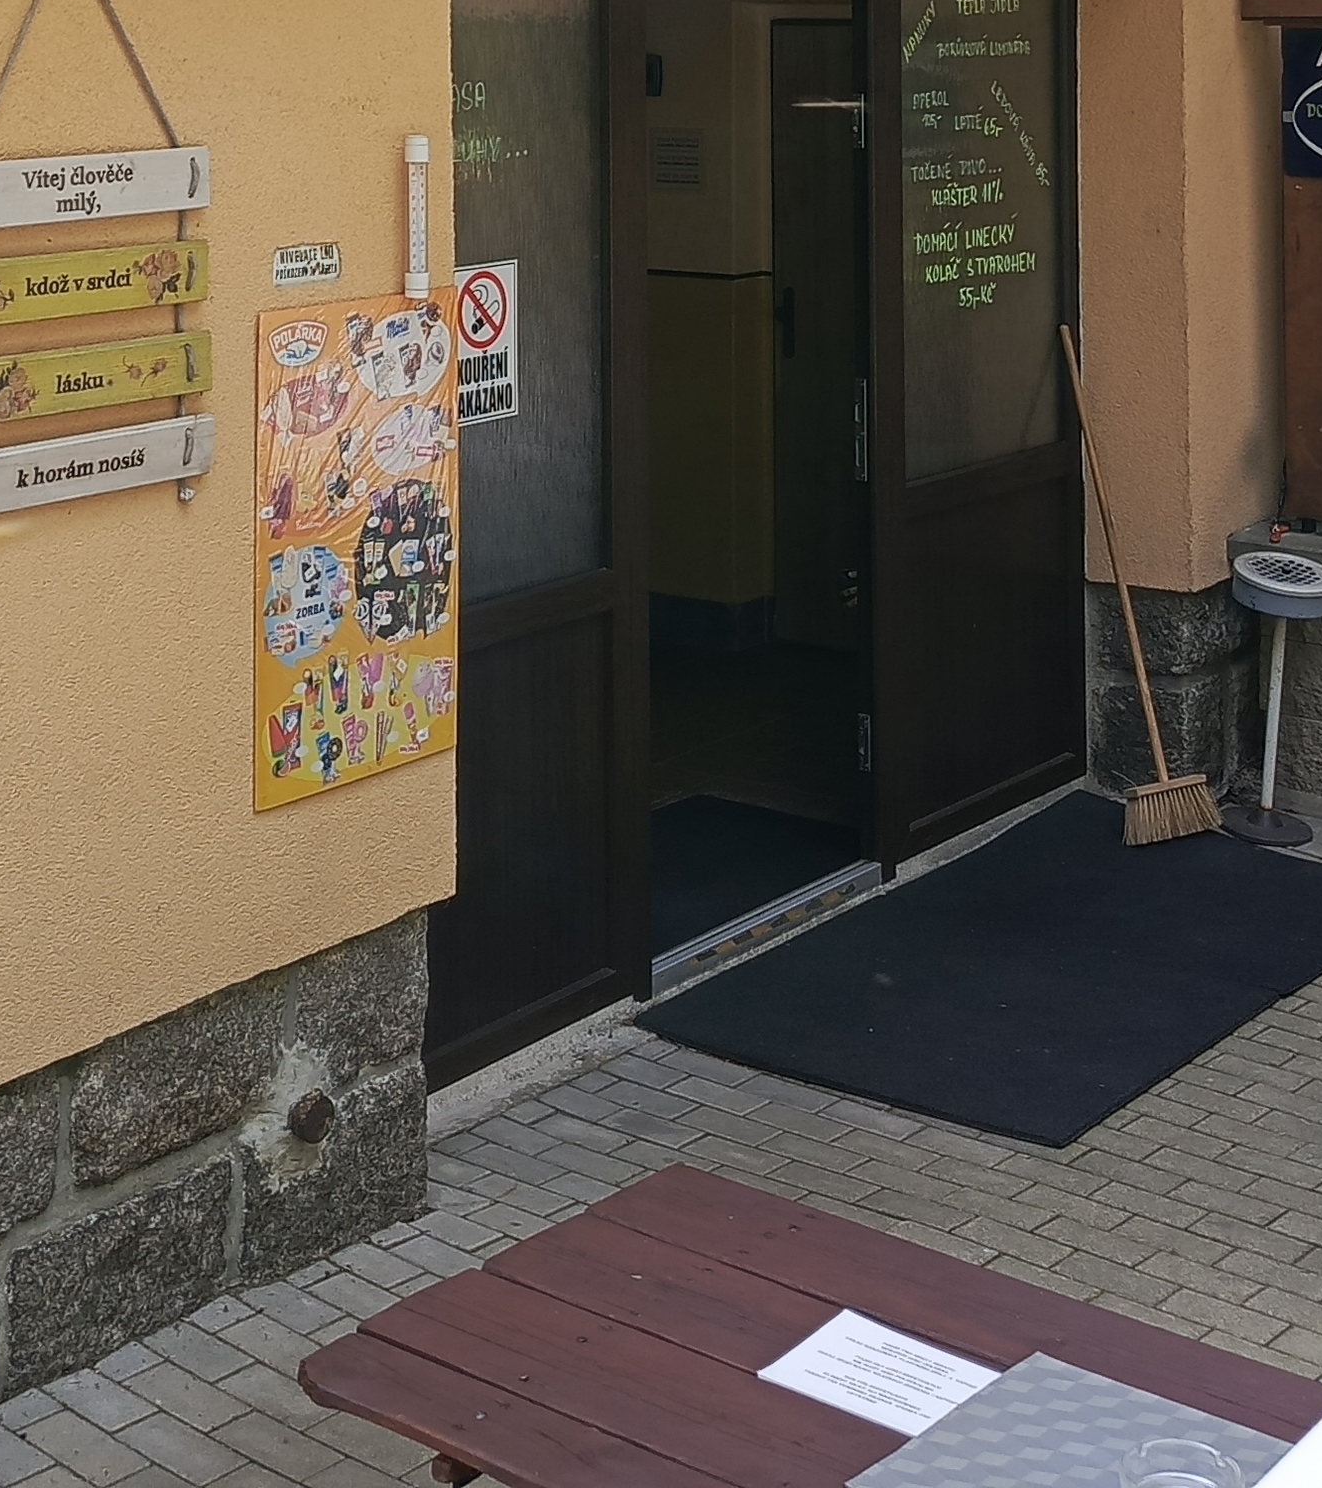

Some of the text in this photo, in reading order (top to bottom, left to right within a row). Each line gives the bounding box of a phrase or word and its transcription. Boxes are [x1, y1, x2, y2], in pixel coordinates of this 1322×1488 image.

[913, 91, 949, 110] APEROL
[22, 163, 133, 191] Vítej člověče
[911, 154, 953, 182] TOČENÉ
[56, 191, 101, 215] milý,
[913, 212, 1017, 255] DOMÁCÍ LINECKÝ
[925, 256, 962, 283] KOLÁČ
[975, 252, 1035, 275] TVAROHEM
[25, 268, 132, 297] kdož v srdci
[457, 346, 508, 386] KOUŘENÍ
[55, 372, 104, 394] lásku
[458, 381, 513, 419] AKÁZÁNO
[16, 448, 146, 488] k horám nosíš
[295, 602, 326, 619] ZORBA
